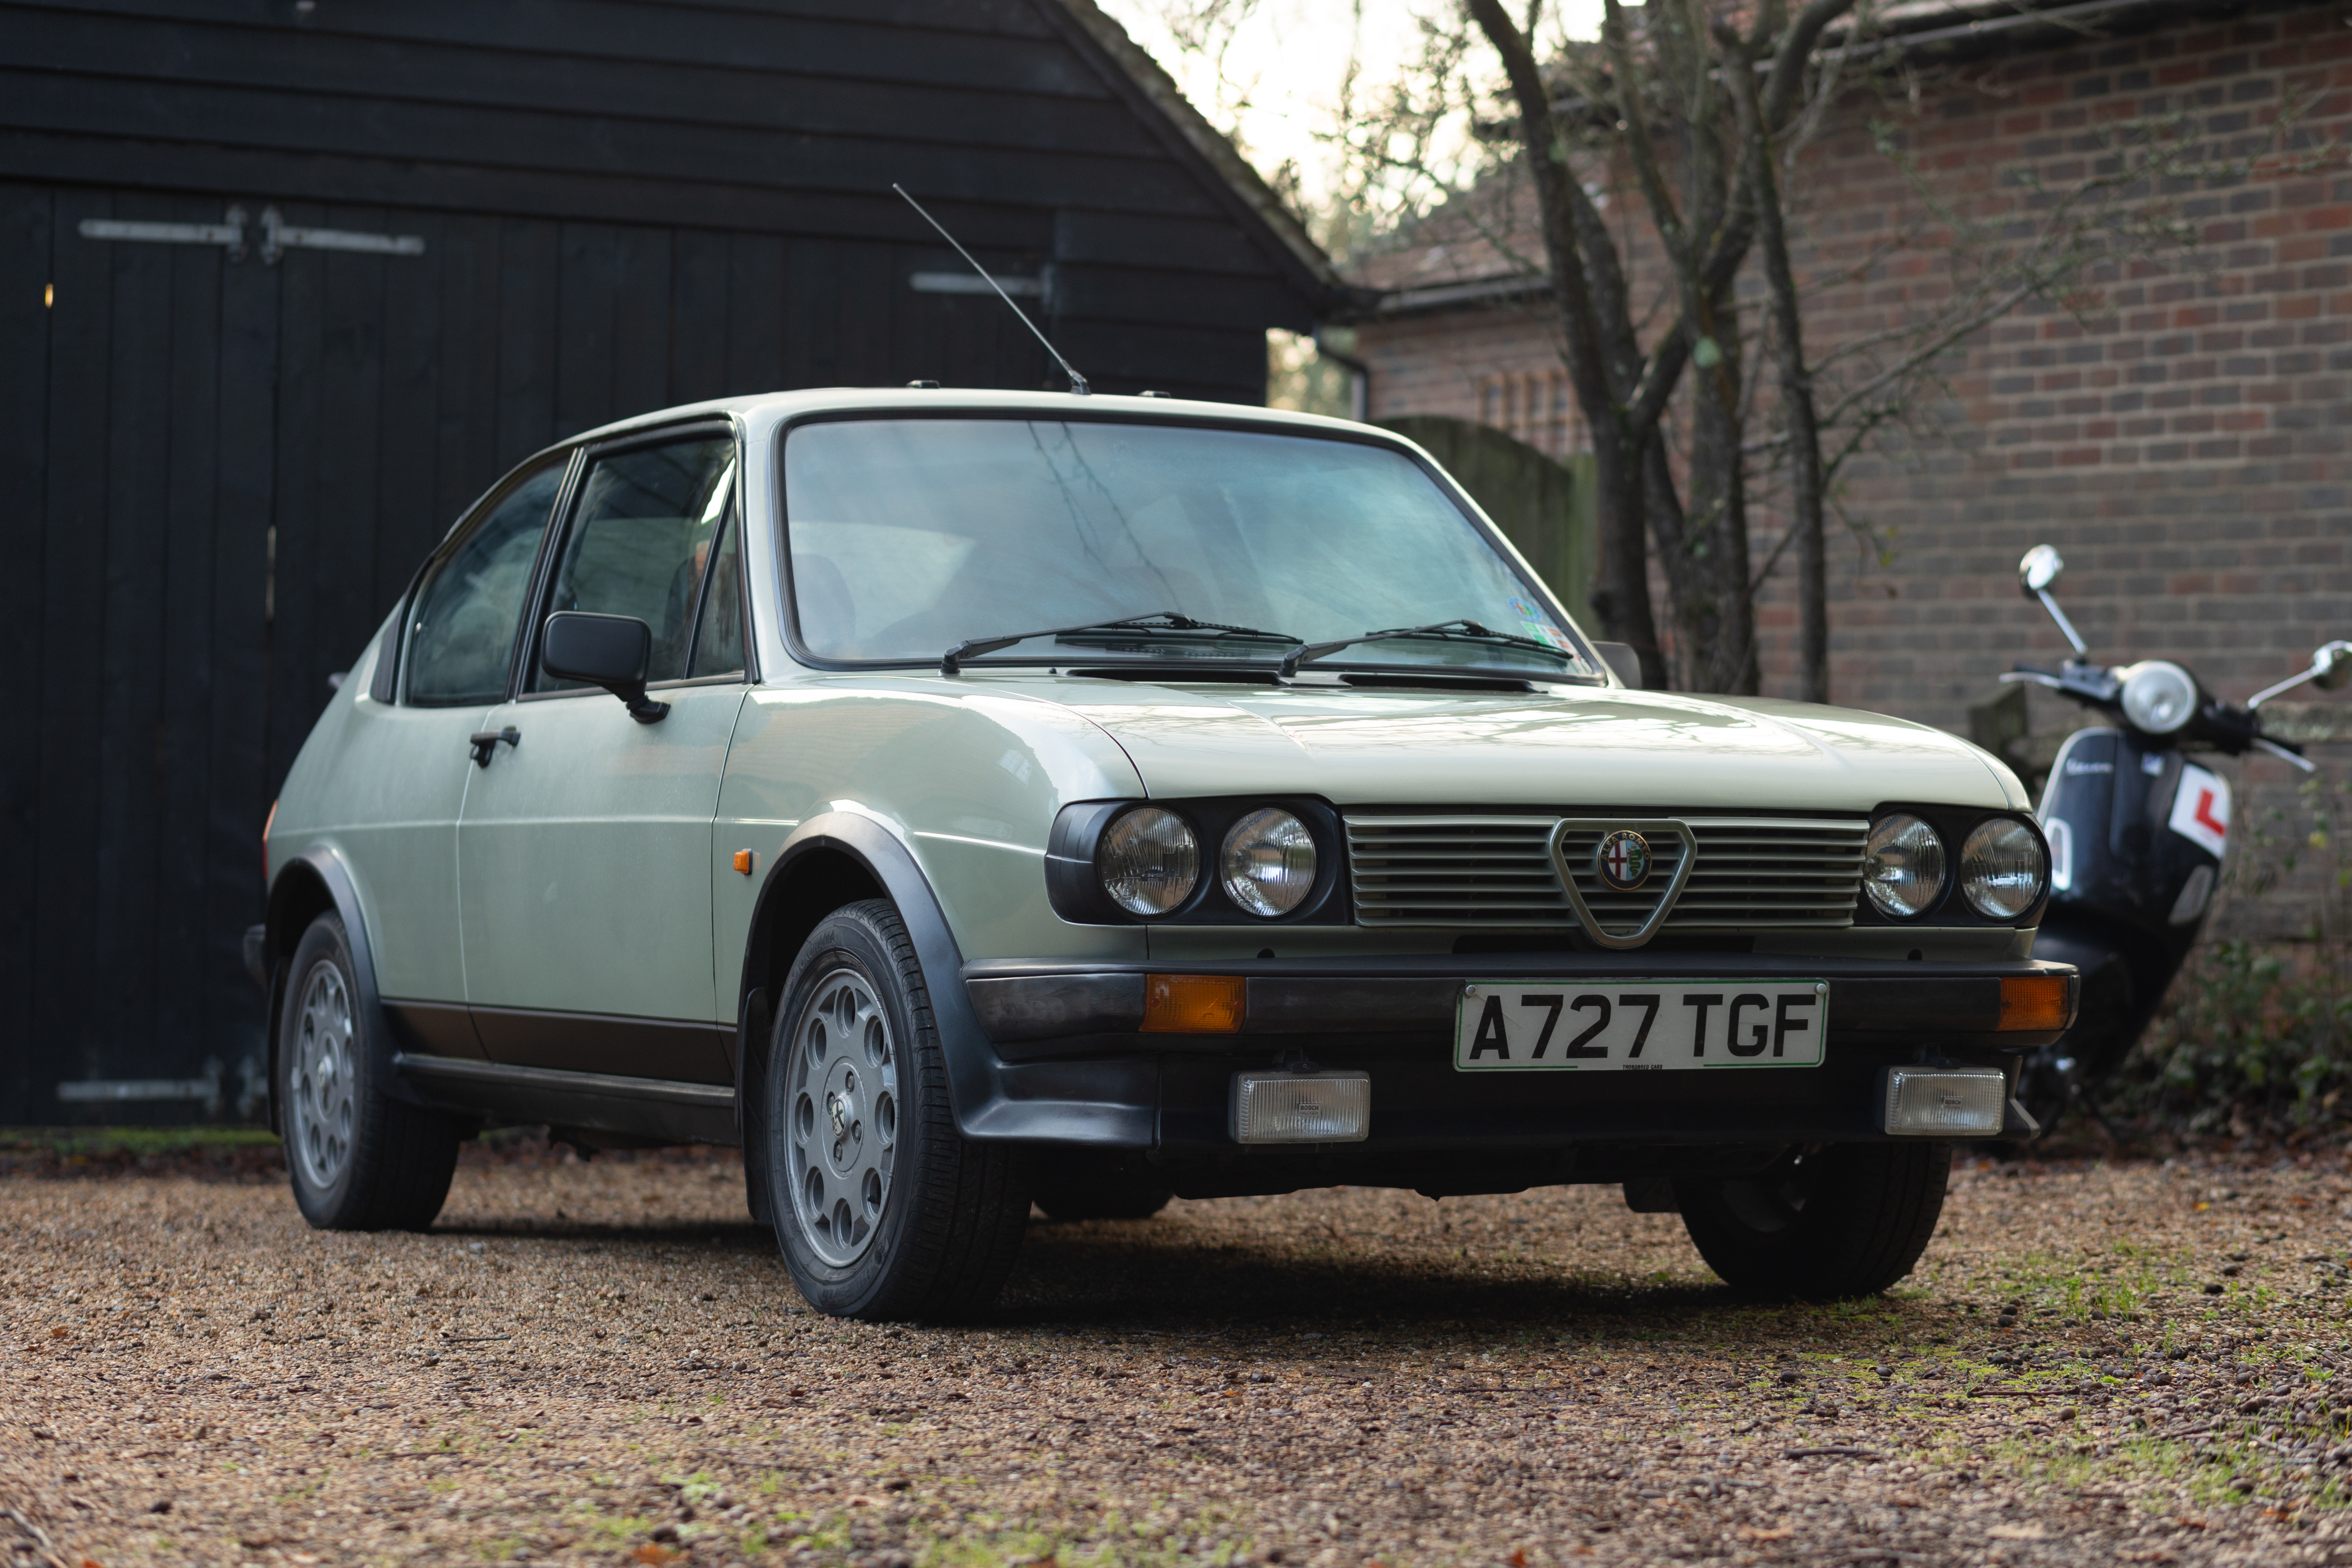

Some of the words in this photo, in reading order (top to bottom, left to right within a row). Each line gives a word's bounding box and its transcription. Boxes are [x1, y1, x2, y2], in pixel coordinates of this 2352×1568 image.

[2195, 788, 2225, 836] L
[1601, 836, 1619, 861] ALFA
[1622, 833, 1649, 860] ROMEO
[1469, 993, 1660, 1060] A727
[1682, 993, 1816, 1058] TGF
